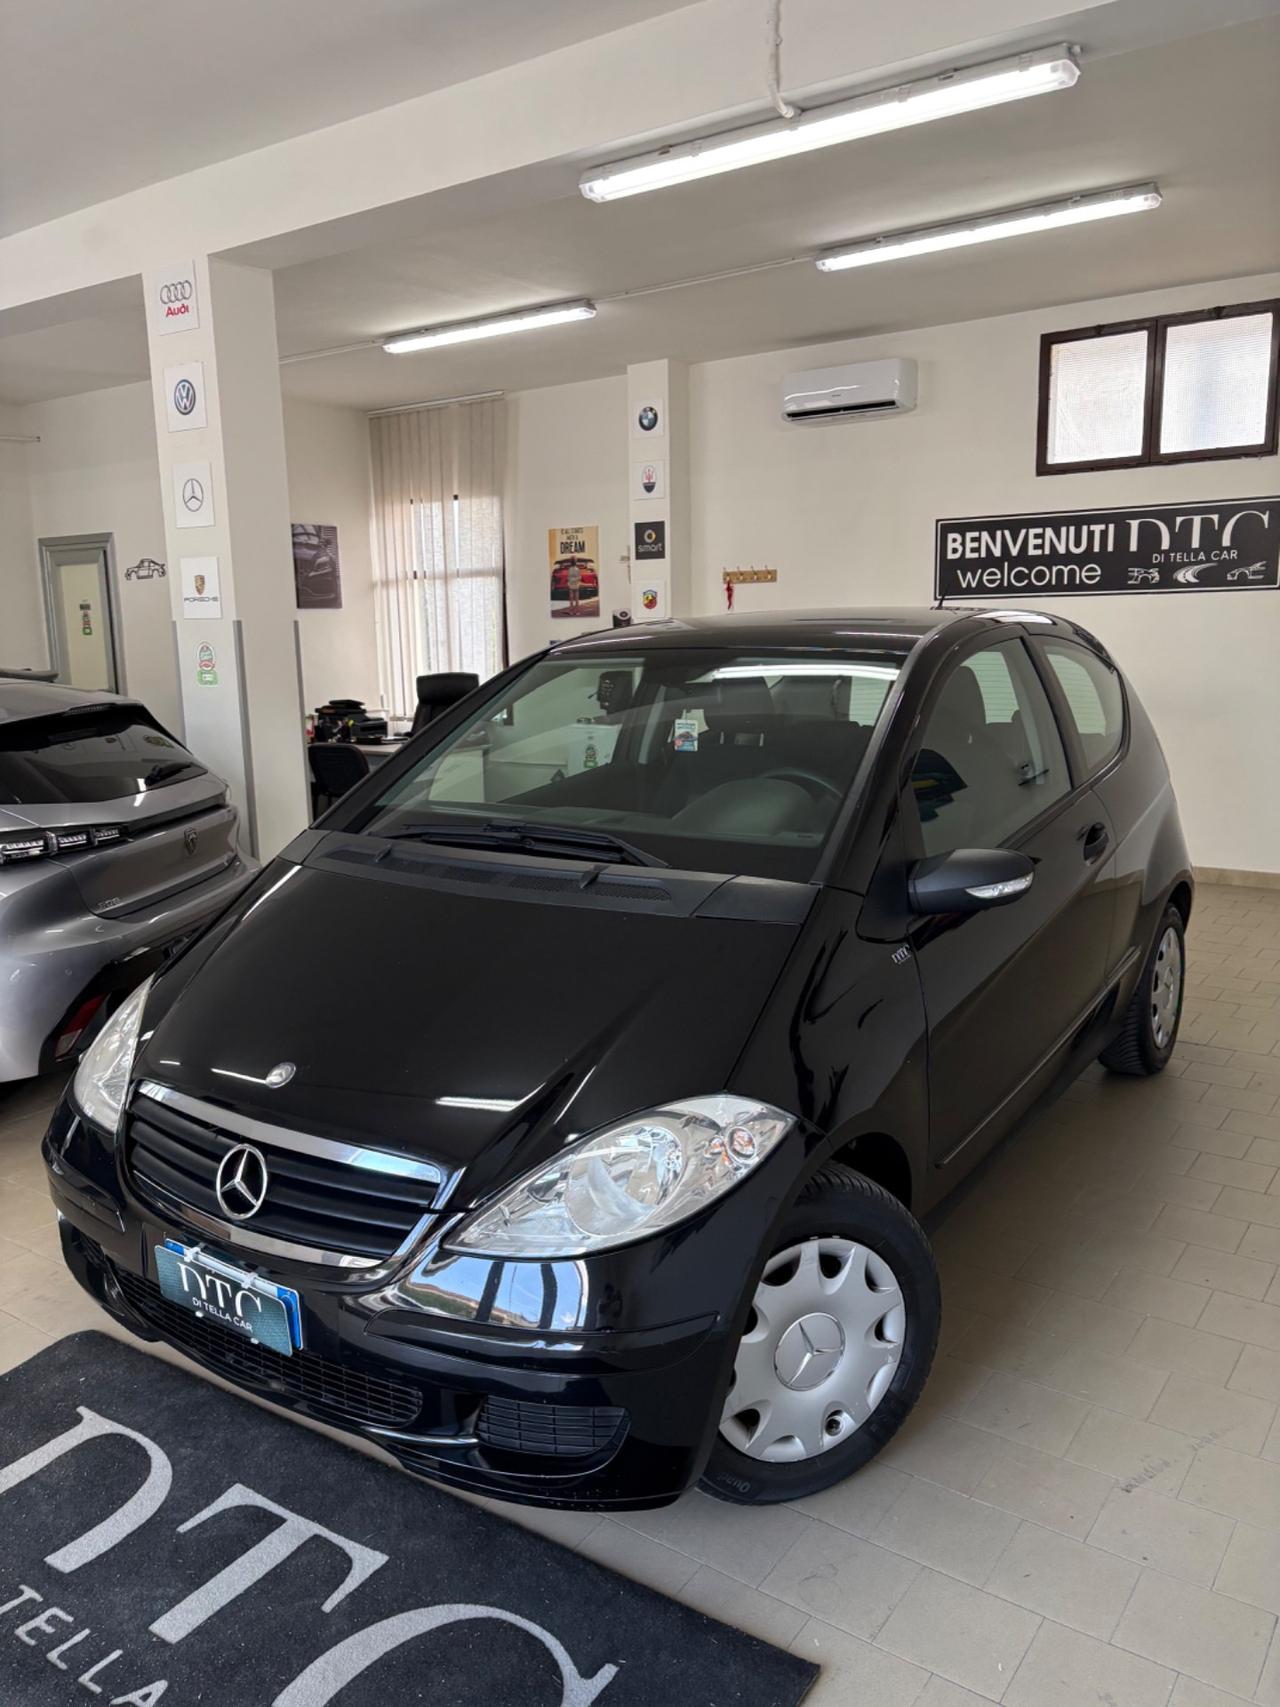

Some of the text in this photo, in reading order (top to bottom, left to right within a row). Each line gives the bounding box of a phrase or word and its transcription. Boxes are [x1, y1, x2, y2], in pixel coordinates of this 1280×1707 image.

[165, 304, 189, 317] Audi
[560, 541, 585, 554] DREAM
[638, 543, 663, 552] smart
[946, 510, 1270, 560] BENVENUTI DTC
[1152, 550, 1238, 563] DI TELLA CAR
[957, 562, 1101, 588] welcome
[177, 1262, 262, 1318] DTC
[192, 1297, 253, 1333] DI TELLA CAR
[0, 1584, 169, 1707] TELLA
